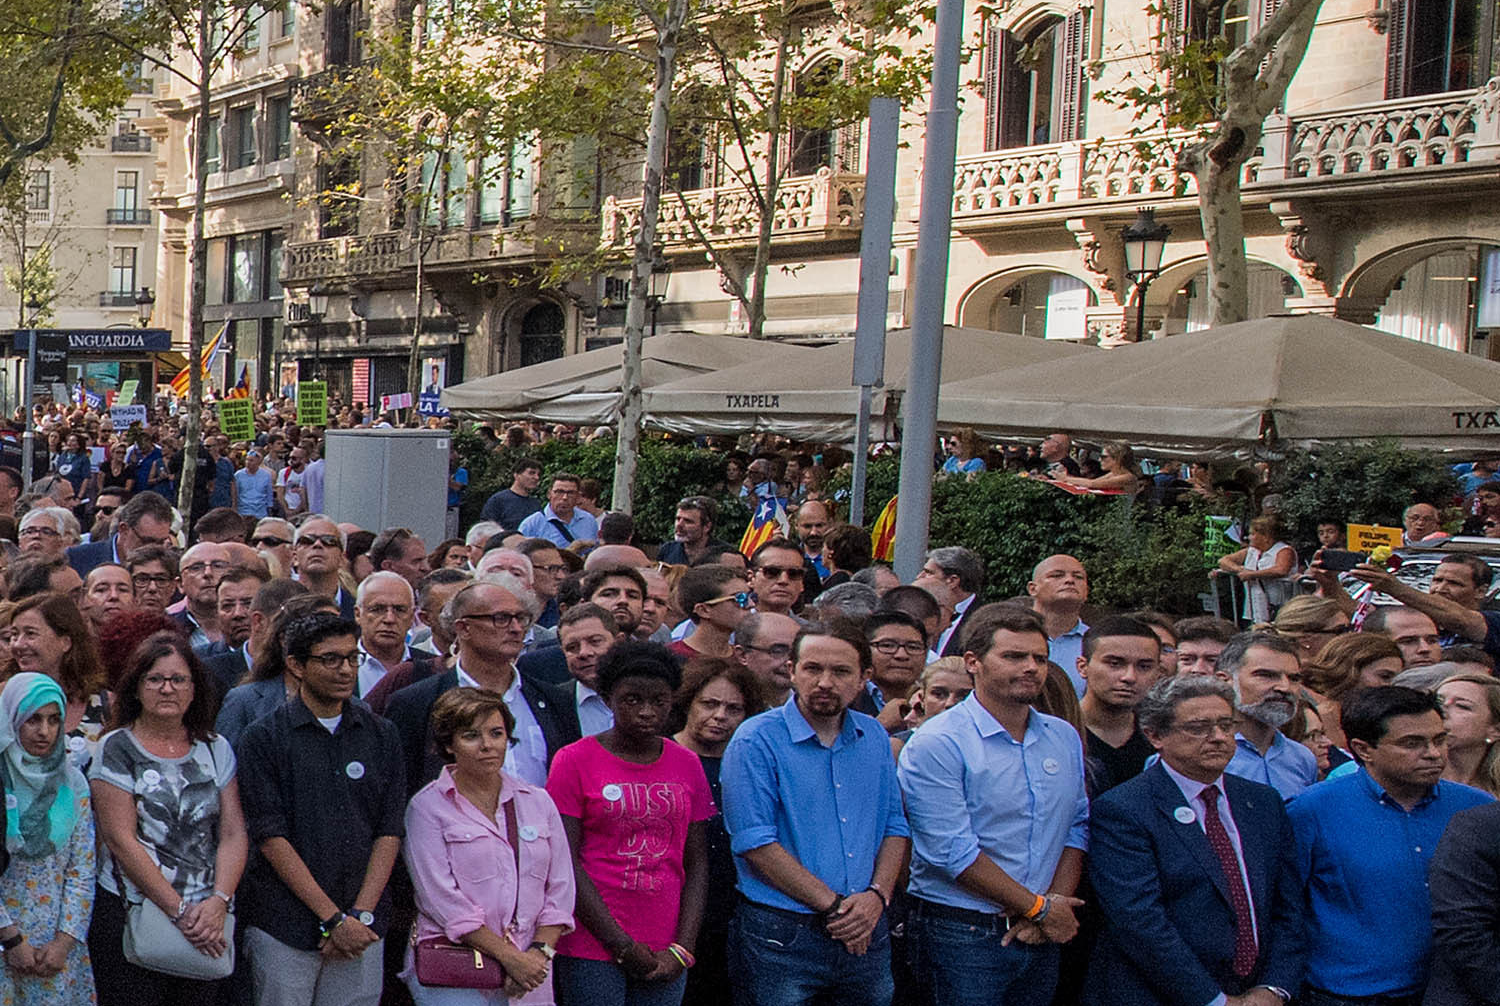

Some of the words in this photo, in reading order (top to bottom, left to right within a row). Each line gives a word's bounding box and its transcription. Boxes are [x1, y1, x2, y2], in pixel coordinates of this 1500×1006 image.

[420, 402, 433, 412] LA
[726, 395, 780, 408] TXAPELA
[1452, 411, 1500, 429] TXA
[603, 782, 685, 820] JUST
[618, 818, 673, 856] DO
